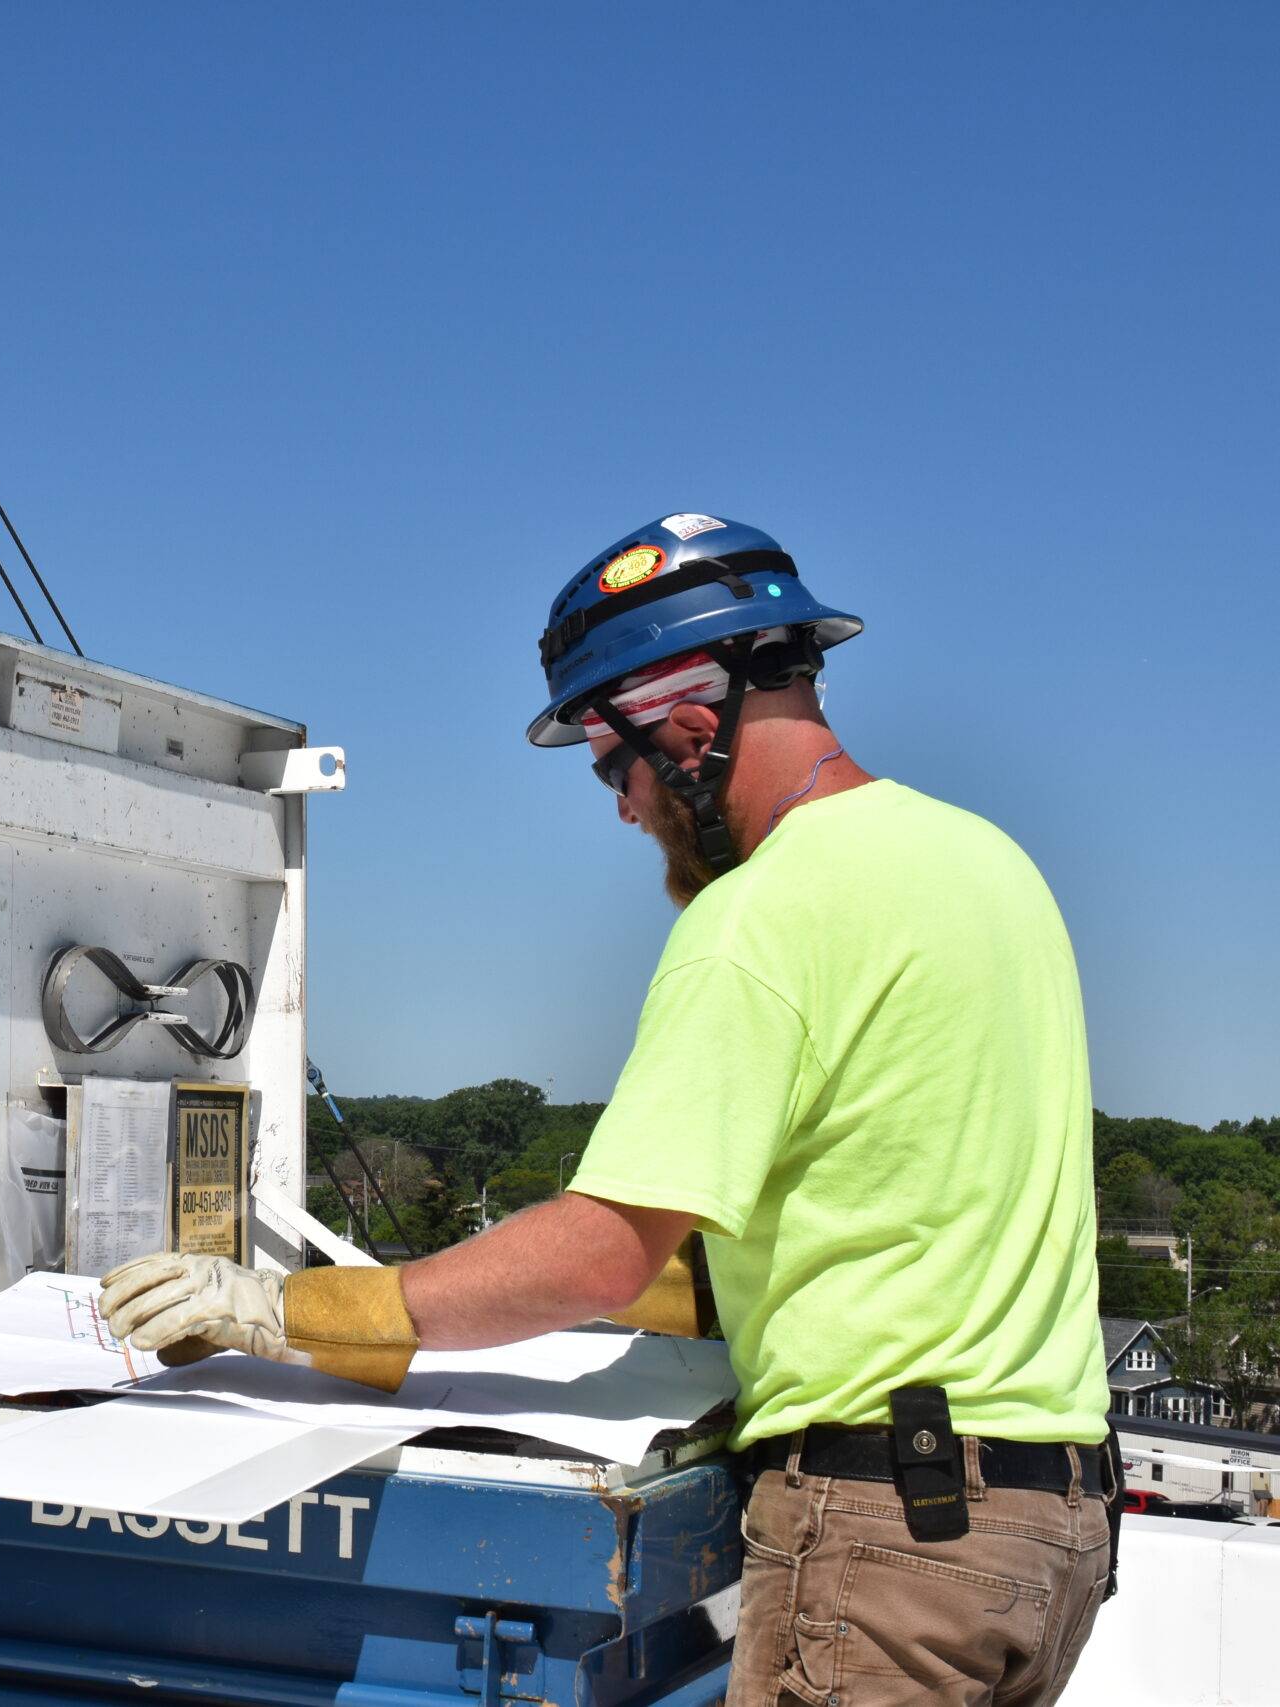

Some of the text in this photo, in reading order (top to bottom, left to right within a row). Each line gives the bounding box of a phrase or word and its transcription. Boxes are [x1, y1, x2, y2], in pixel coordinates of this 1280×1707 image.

[186, 1113, 229, 1158] MSDS
[183, 1191, 232, 1214] 800-451-8346
[1231, 1449, 1250, 1457] MIRON
[1230, 1458, 1251, 1466] OFFICE
[913, 1495, 957, 1507] LEATHERMAN
